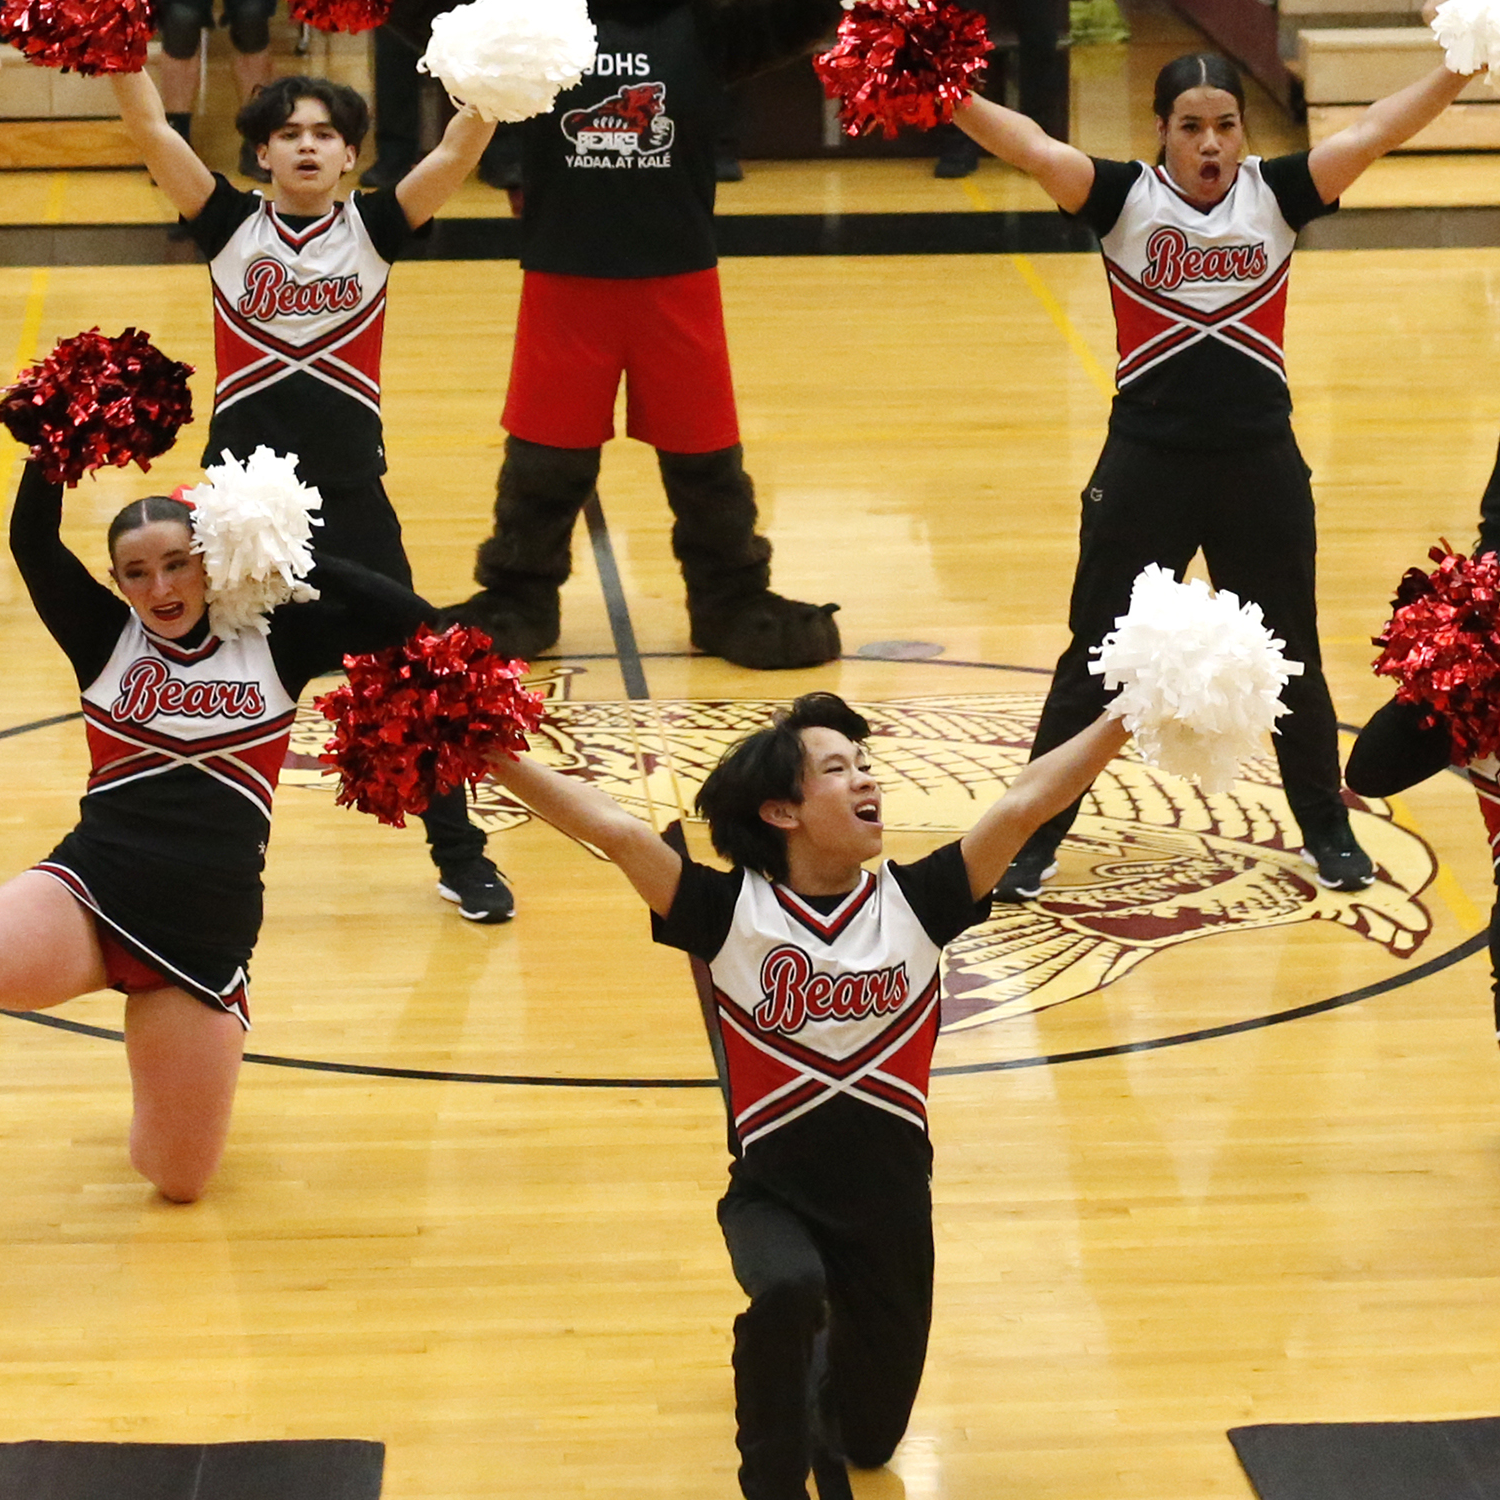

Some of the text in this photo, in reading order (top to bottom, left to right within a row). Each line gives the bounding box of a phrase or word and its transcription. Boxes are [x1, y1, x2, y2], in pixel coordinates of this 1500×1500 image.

[238, 257, 362, 322] Bears
[1140, 225, 1267, 291] Bears
[112, 655, 266, 723] Bears
[755, 943, 909, 1035] Bears
